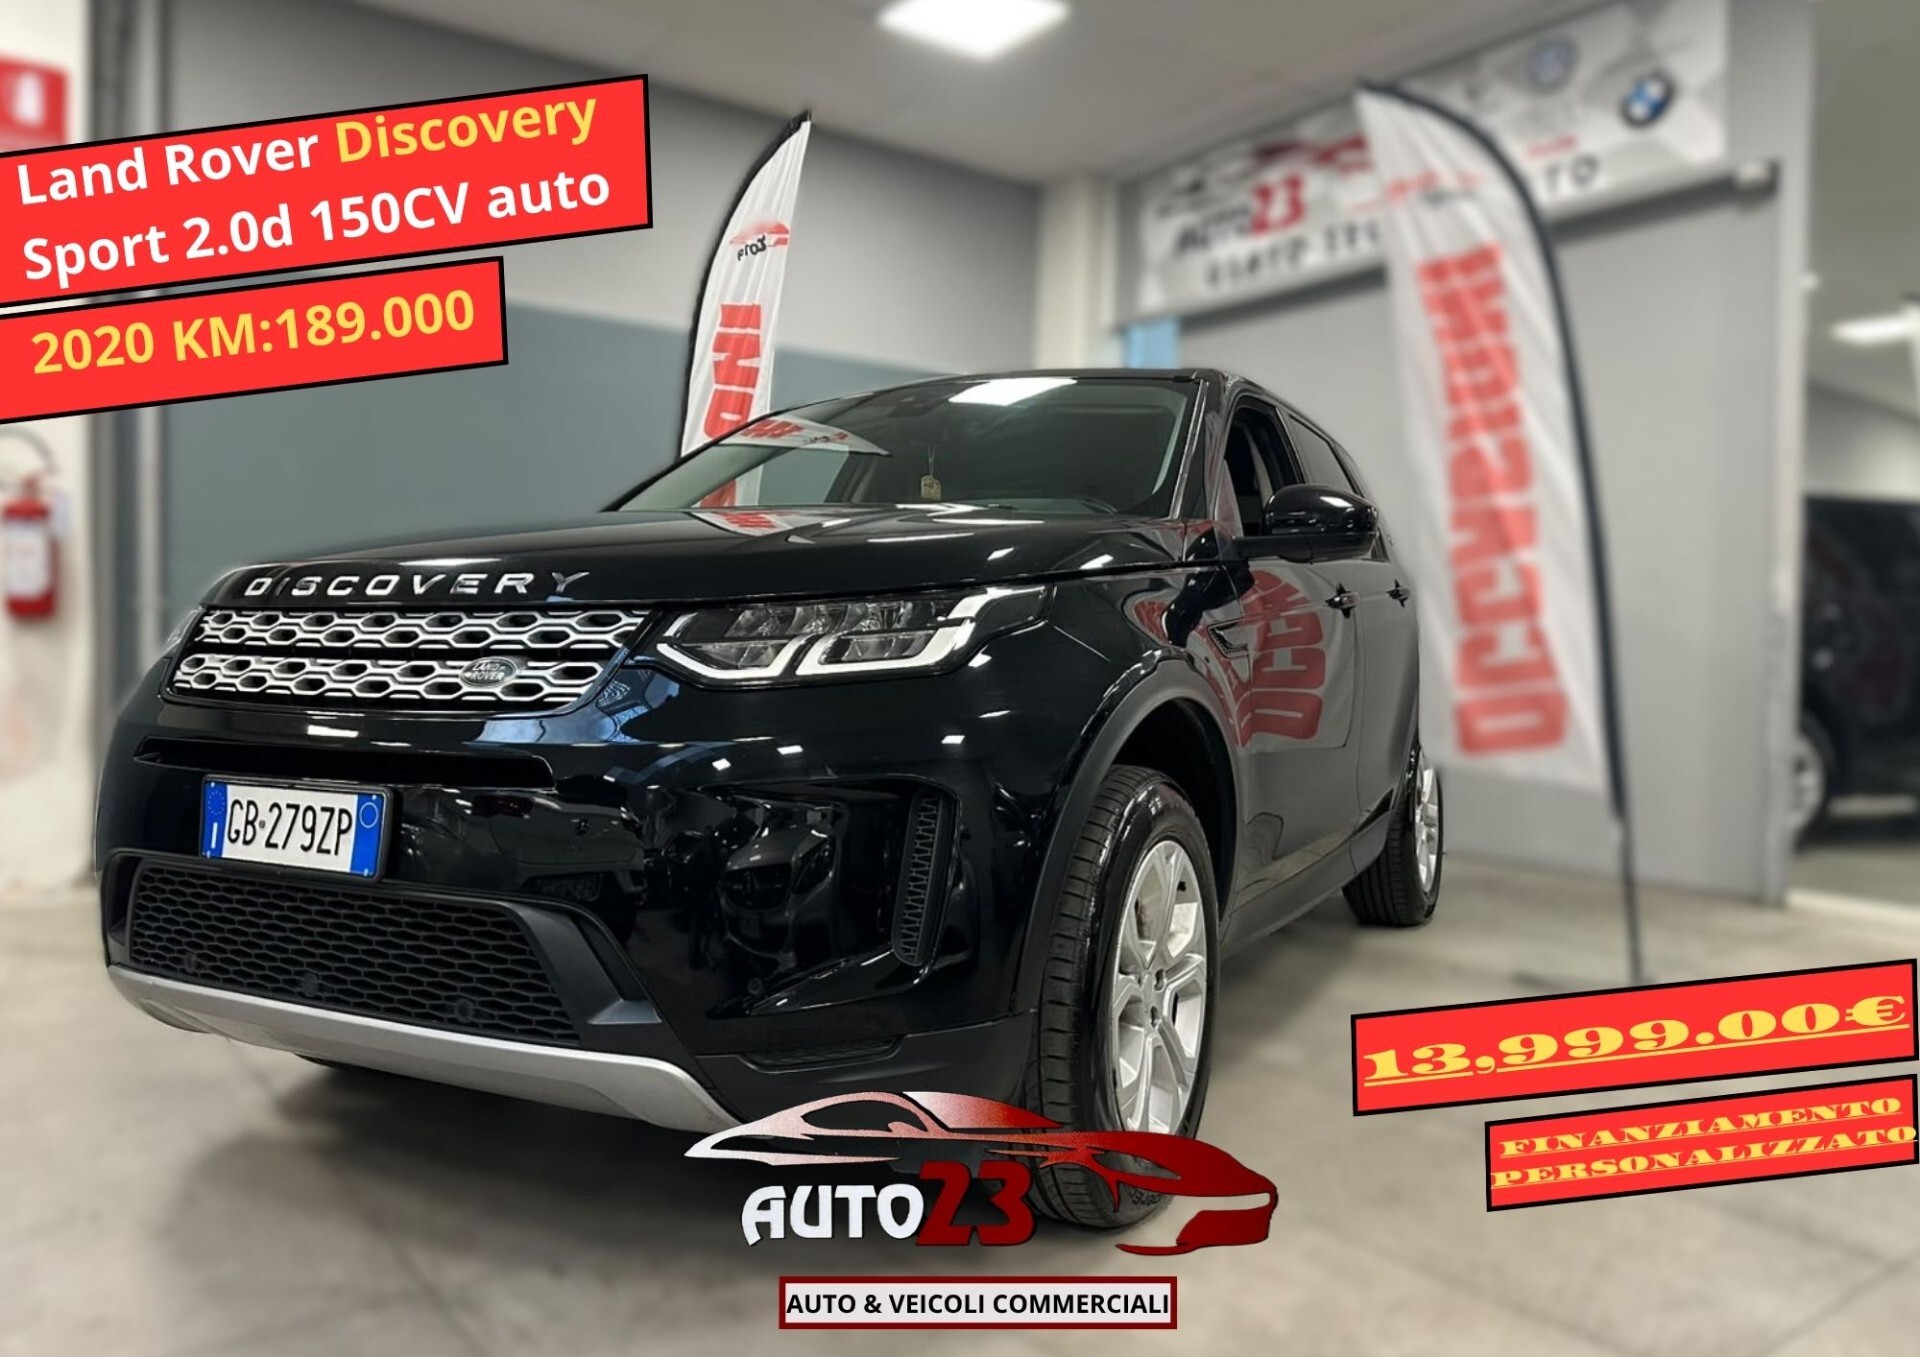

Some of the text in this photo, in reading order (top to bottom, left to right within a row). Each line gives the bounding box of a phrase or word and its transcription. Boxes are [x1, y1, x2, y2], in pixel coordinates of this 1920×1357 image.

[703, 303, 763, 440] ONI
[244, 571, 591, 598] DISCOVERY
[472, 662, 501, 671] LAND
[470, 671, 506, 681] ROVER
